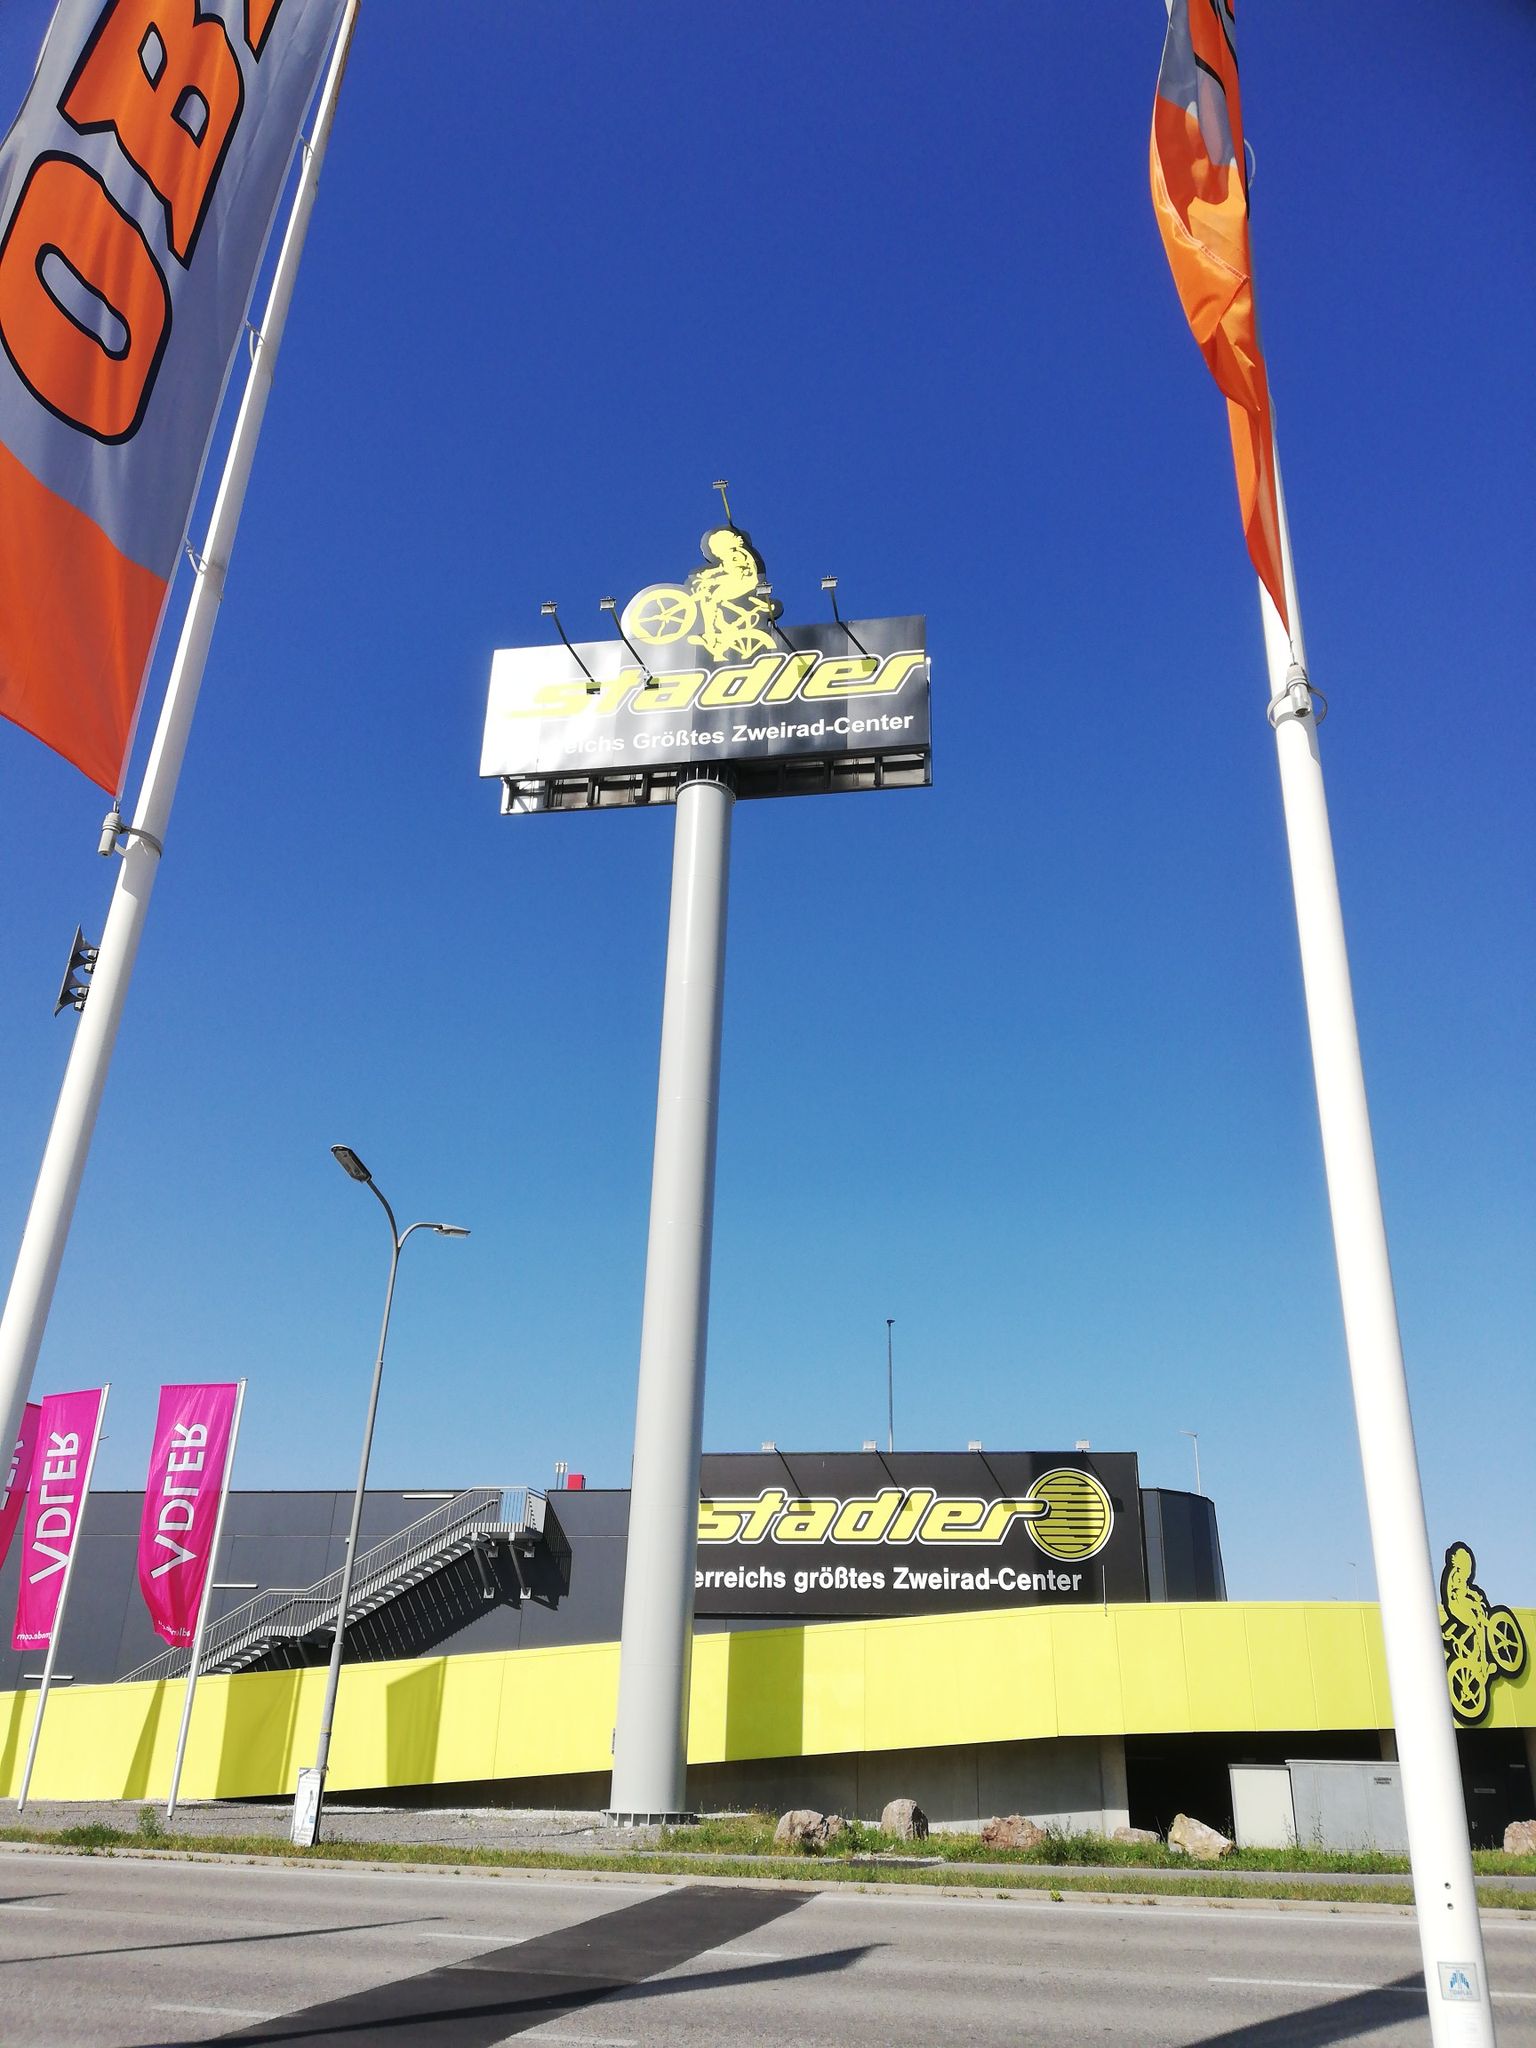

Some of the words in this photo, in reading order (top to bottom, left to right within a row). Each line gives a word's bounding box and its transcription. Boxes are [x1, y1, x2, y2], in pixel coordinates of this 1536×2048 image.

[0, 0, 283, 446] OB
[507, 650, 925, 718] stadler
[633, 728, 725, 751] Größtes
[732, 713, 914, 743] Zweirad-Center
[694, 1486, 1051, 1546] stadler
[693, 1564, 787, 1590] erreichs
[793, 1564, 886, 1594] größtes
[893, 1567, 1082, 1592] Zweirad-Center
